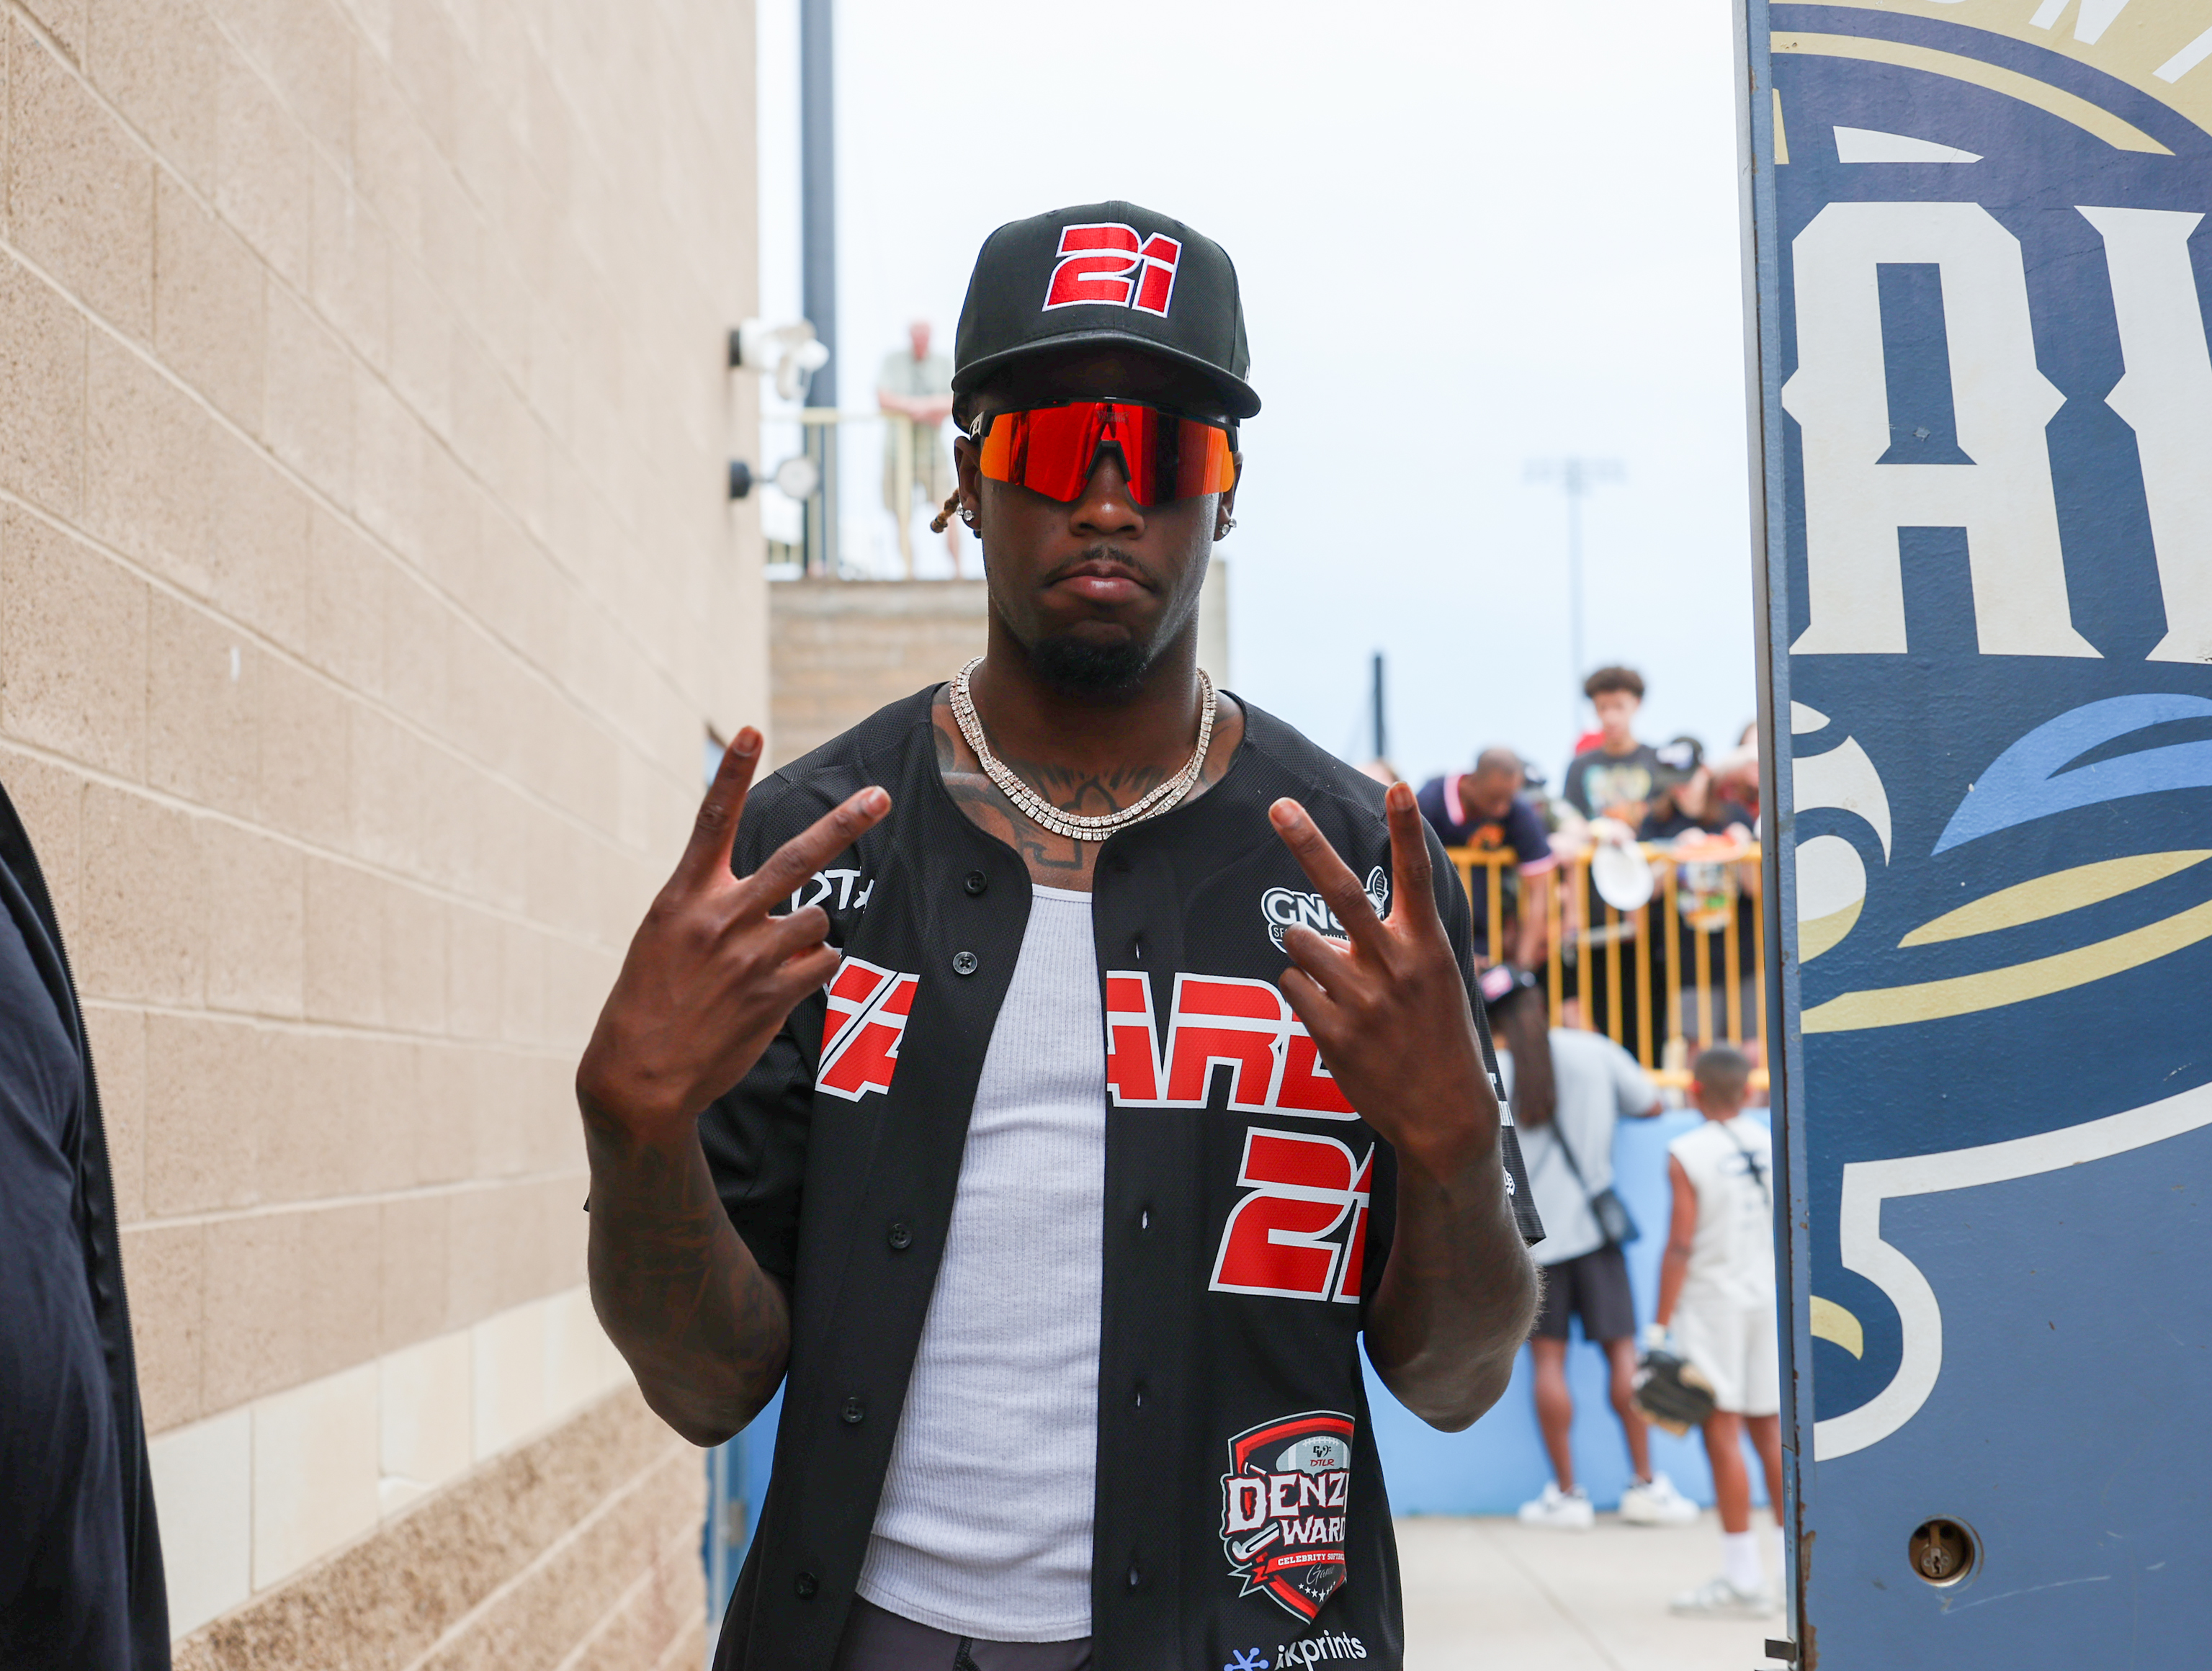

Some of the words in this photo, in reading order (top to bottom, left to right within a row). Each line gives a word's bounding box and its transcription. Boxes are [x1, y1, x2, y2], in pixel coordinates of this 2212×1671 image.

[1042, 222, 1183, 318] 21
[1208, 1126, 1374, 1304] 21
[1310, 1459, 1335, 1467] DTLR
[1225, 1471, 1349, 1535] DENZ
[1278, 1554, 1326, 1566] CELEBRITY
